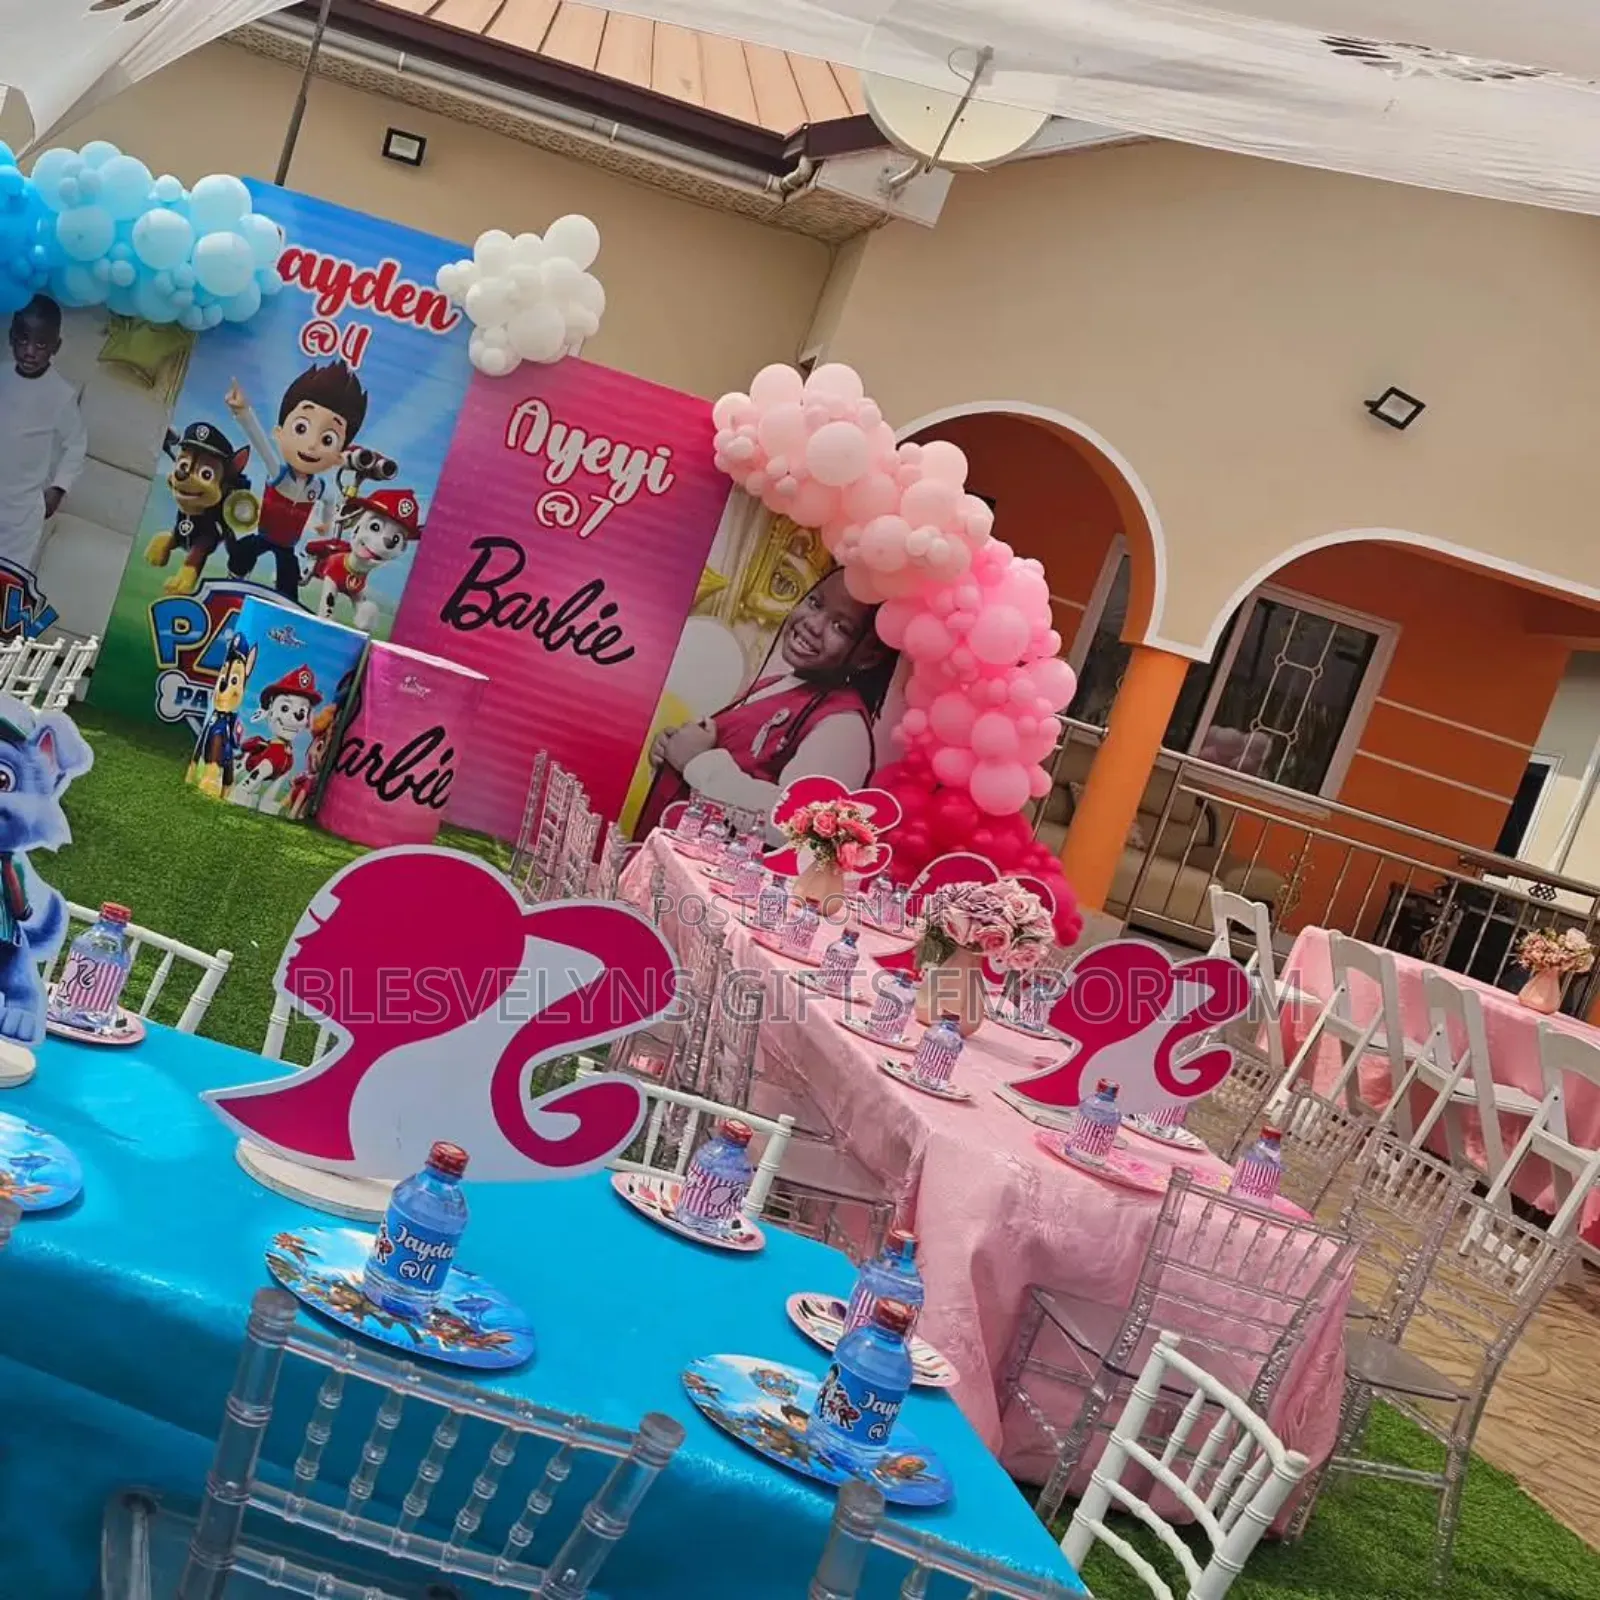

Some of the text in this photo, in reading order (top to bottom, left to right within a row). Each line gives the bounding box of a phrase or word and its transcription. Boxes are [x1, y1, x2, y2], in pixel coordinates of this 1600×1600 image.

[275, 246, 461, 332] ayden
[301, 319, 371, 368] @4
[507, 398, 674, 504] Ayeyi
[536, 489, 616, 539] @7
[440, 536, 635, 665] Barbie
[334, 726, 454, 809] arbie
